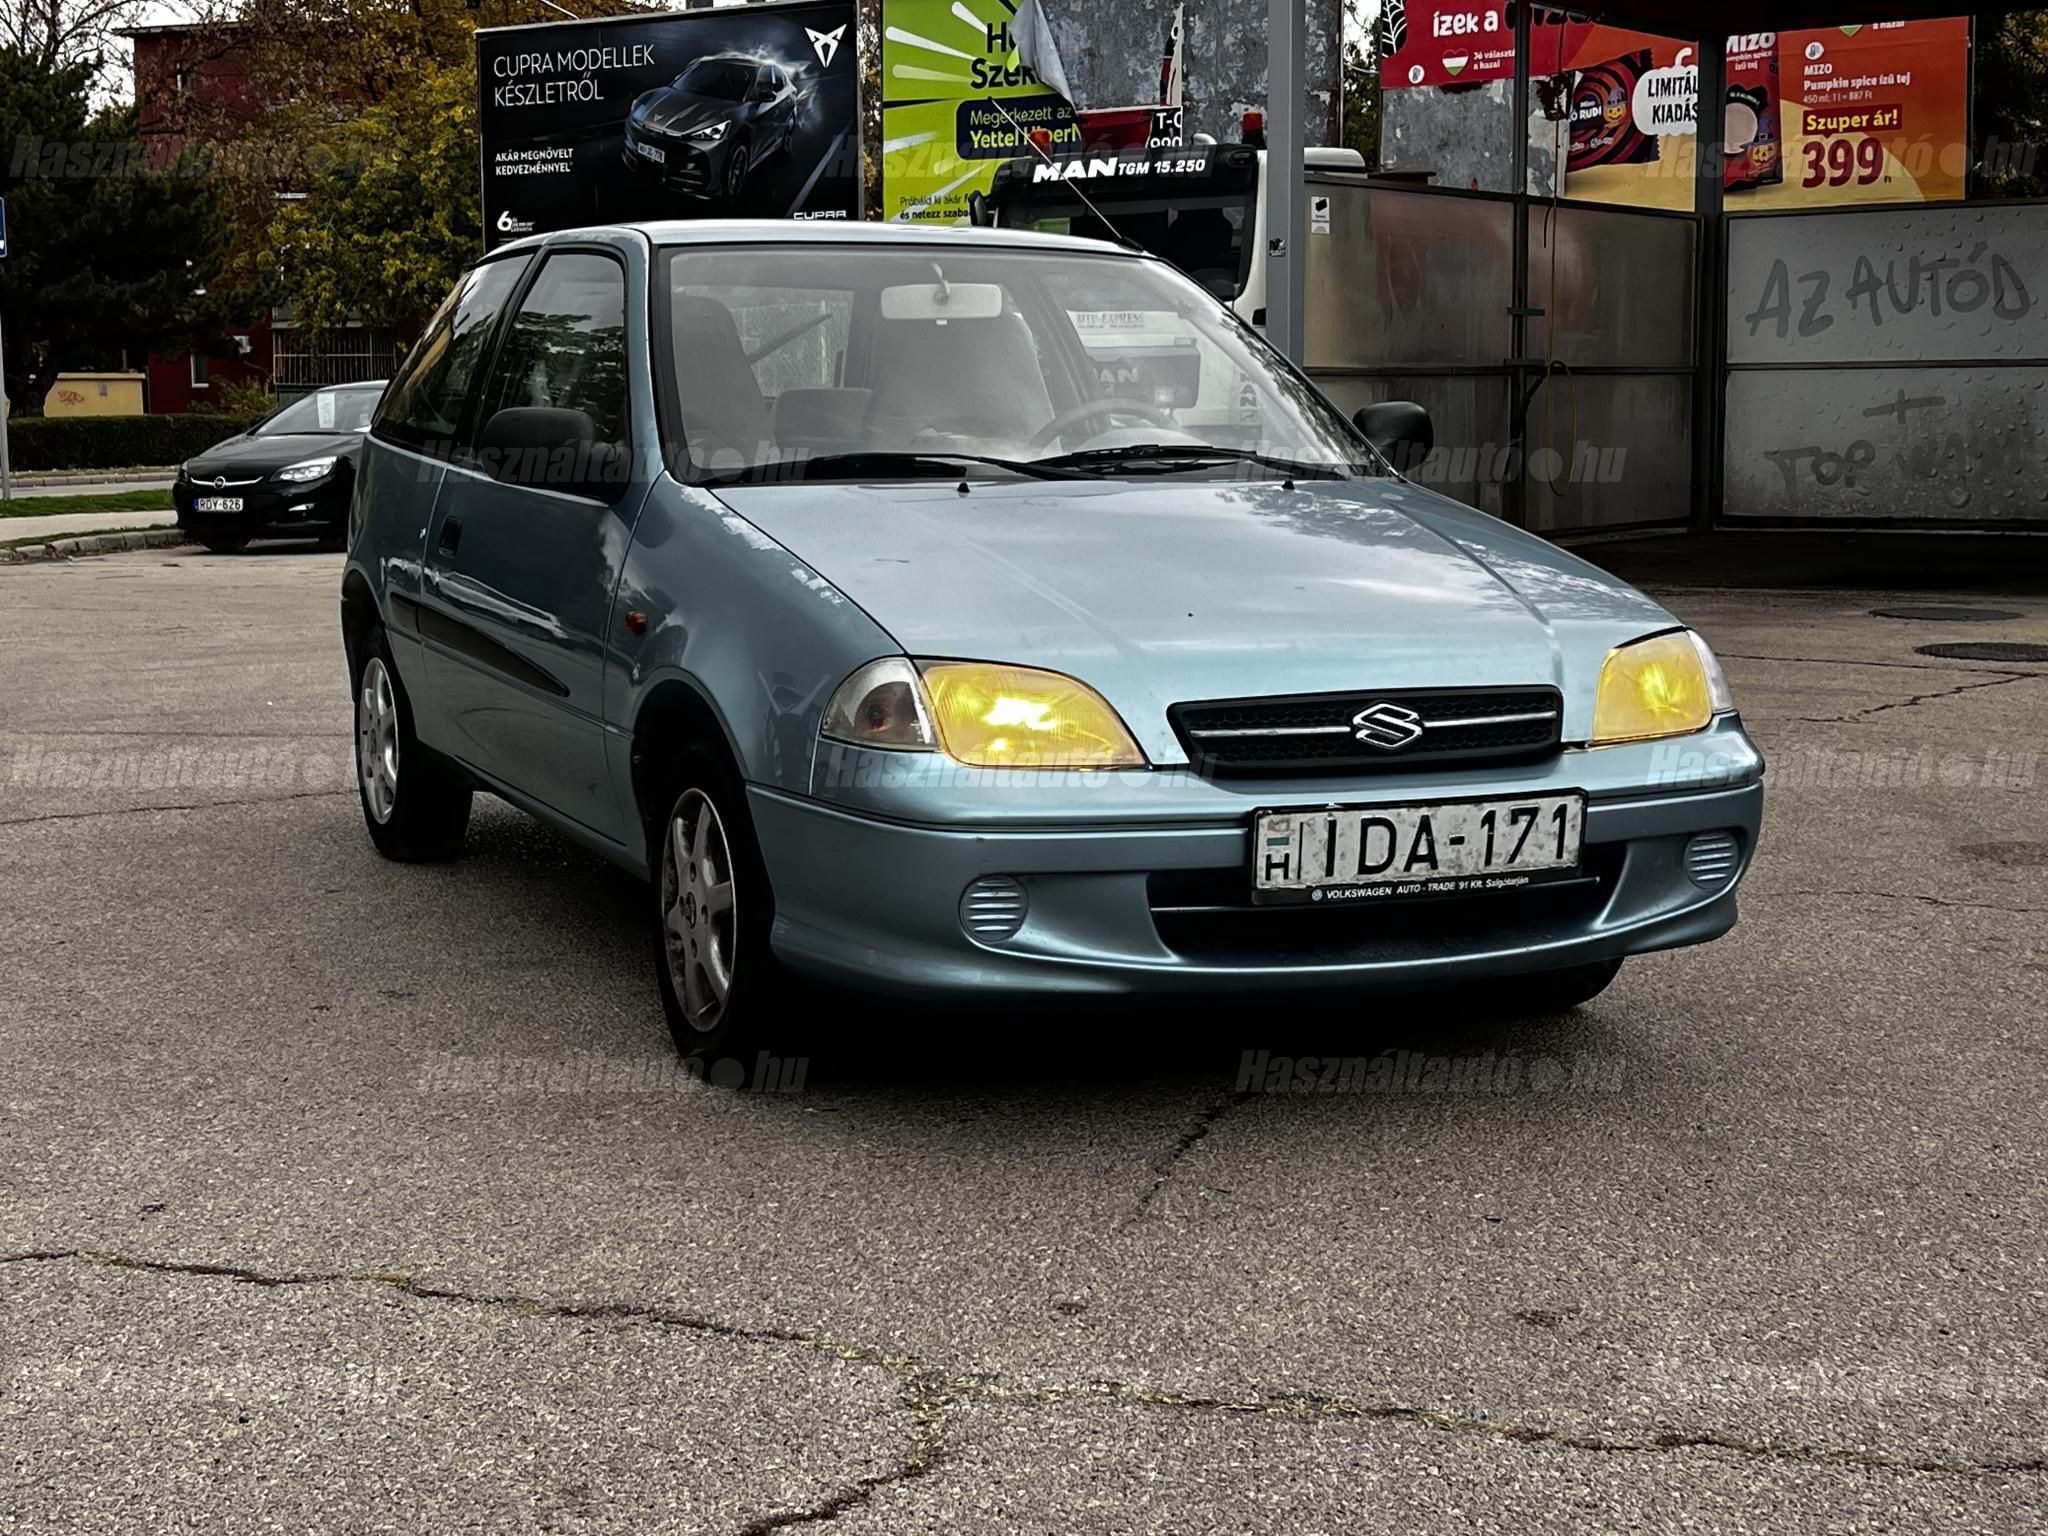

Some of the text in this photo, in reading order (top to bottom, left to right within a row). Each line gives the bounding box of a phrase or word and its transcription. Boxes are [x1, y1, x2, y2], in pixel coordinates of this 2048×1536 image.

[1433, 11, 1479, 38] ízek
[1484, 10, 1499, 32] a
[494, 44, 655, 77] CUPRA MODELLEK
[1804, 64, 1833, 76] MIZO
[495, 71, 604, 107] KÉSZLETRŐL
[970, 106, 1072, 129] Megérkezett az
[1579, 106, 1602, 120] RUDI
[1807, 109, 1898, 132] Szuper ár!
[970, 126, 1019, 149] Yettel
[495, 147, 574, 162] AKÁR MEGNÖVELT
[1802, 137, 1884, 188] 399
[1032, 157, 1206, 183] MAN TGM 15.250
[497, 210, 512, 231] 6
[794, 210, 847, 220] CUPRA
[900, 210, 910, 220] és
[911, 210, 940, 219] netezz
[1846, 241, 2031, 326] AUTÓD
[1324, 803, 1568, 877] IDA-171
[1326, 886, 1392, 899] VOLKSWAGEN
[1396, 884, 1420, 894] AUTO
[1428, 882, 1455, 892] TRADE
